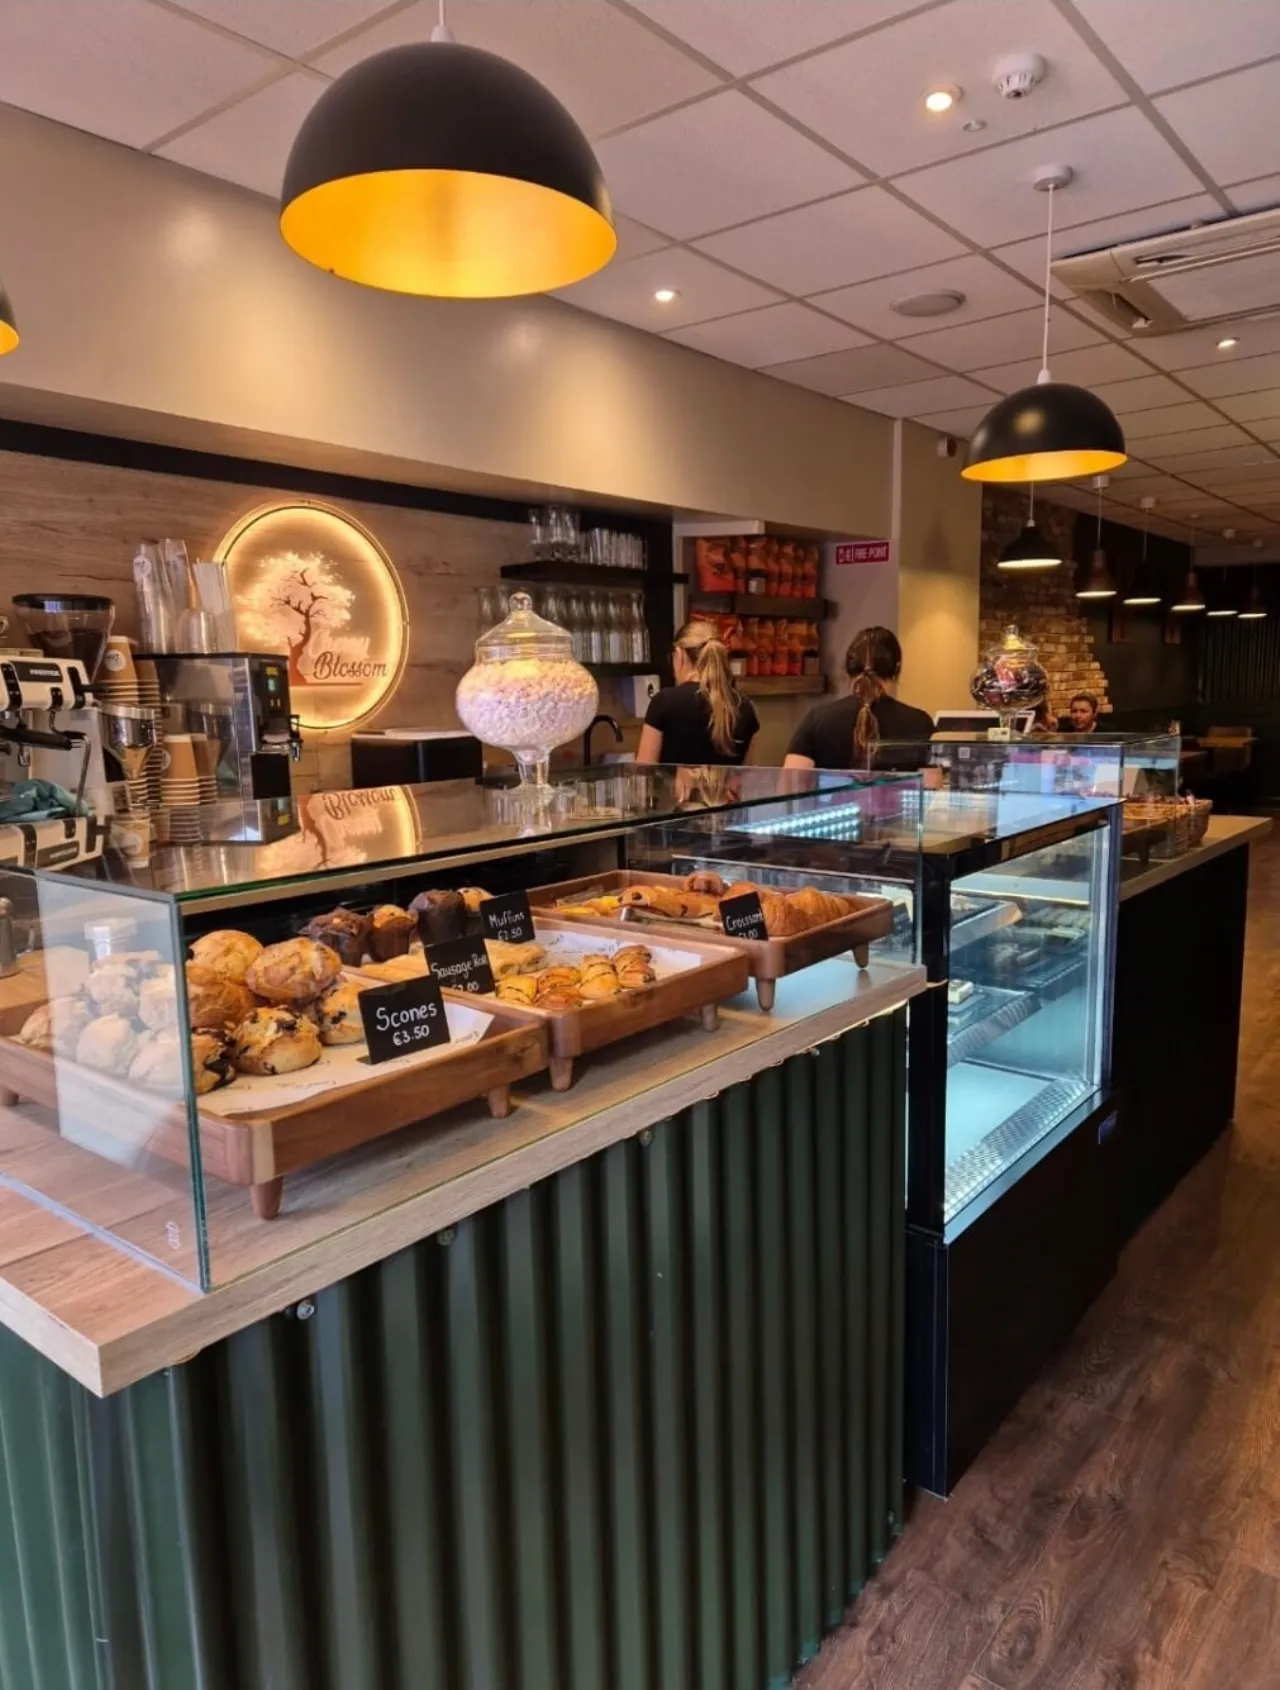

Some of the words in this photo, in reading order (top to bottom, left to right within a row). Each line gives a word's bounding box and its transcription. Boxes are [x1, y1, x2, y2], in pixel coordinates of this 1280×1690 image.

[313, 651, 388, 680] Blossom
[488, 909, 525, 928] Muffins
[430, 960, 474, 980] Sausage
[376, 1002, 438, 1031] Scones
[393, 1024, 430, 1046] €3.50
